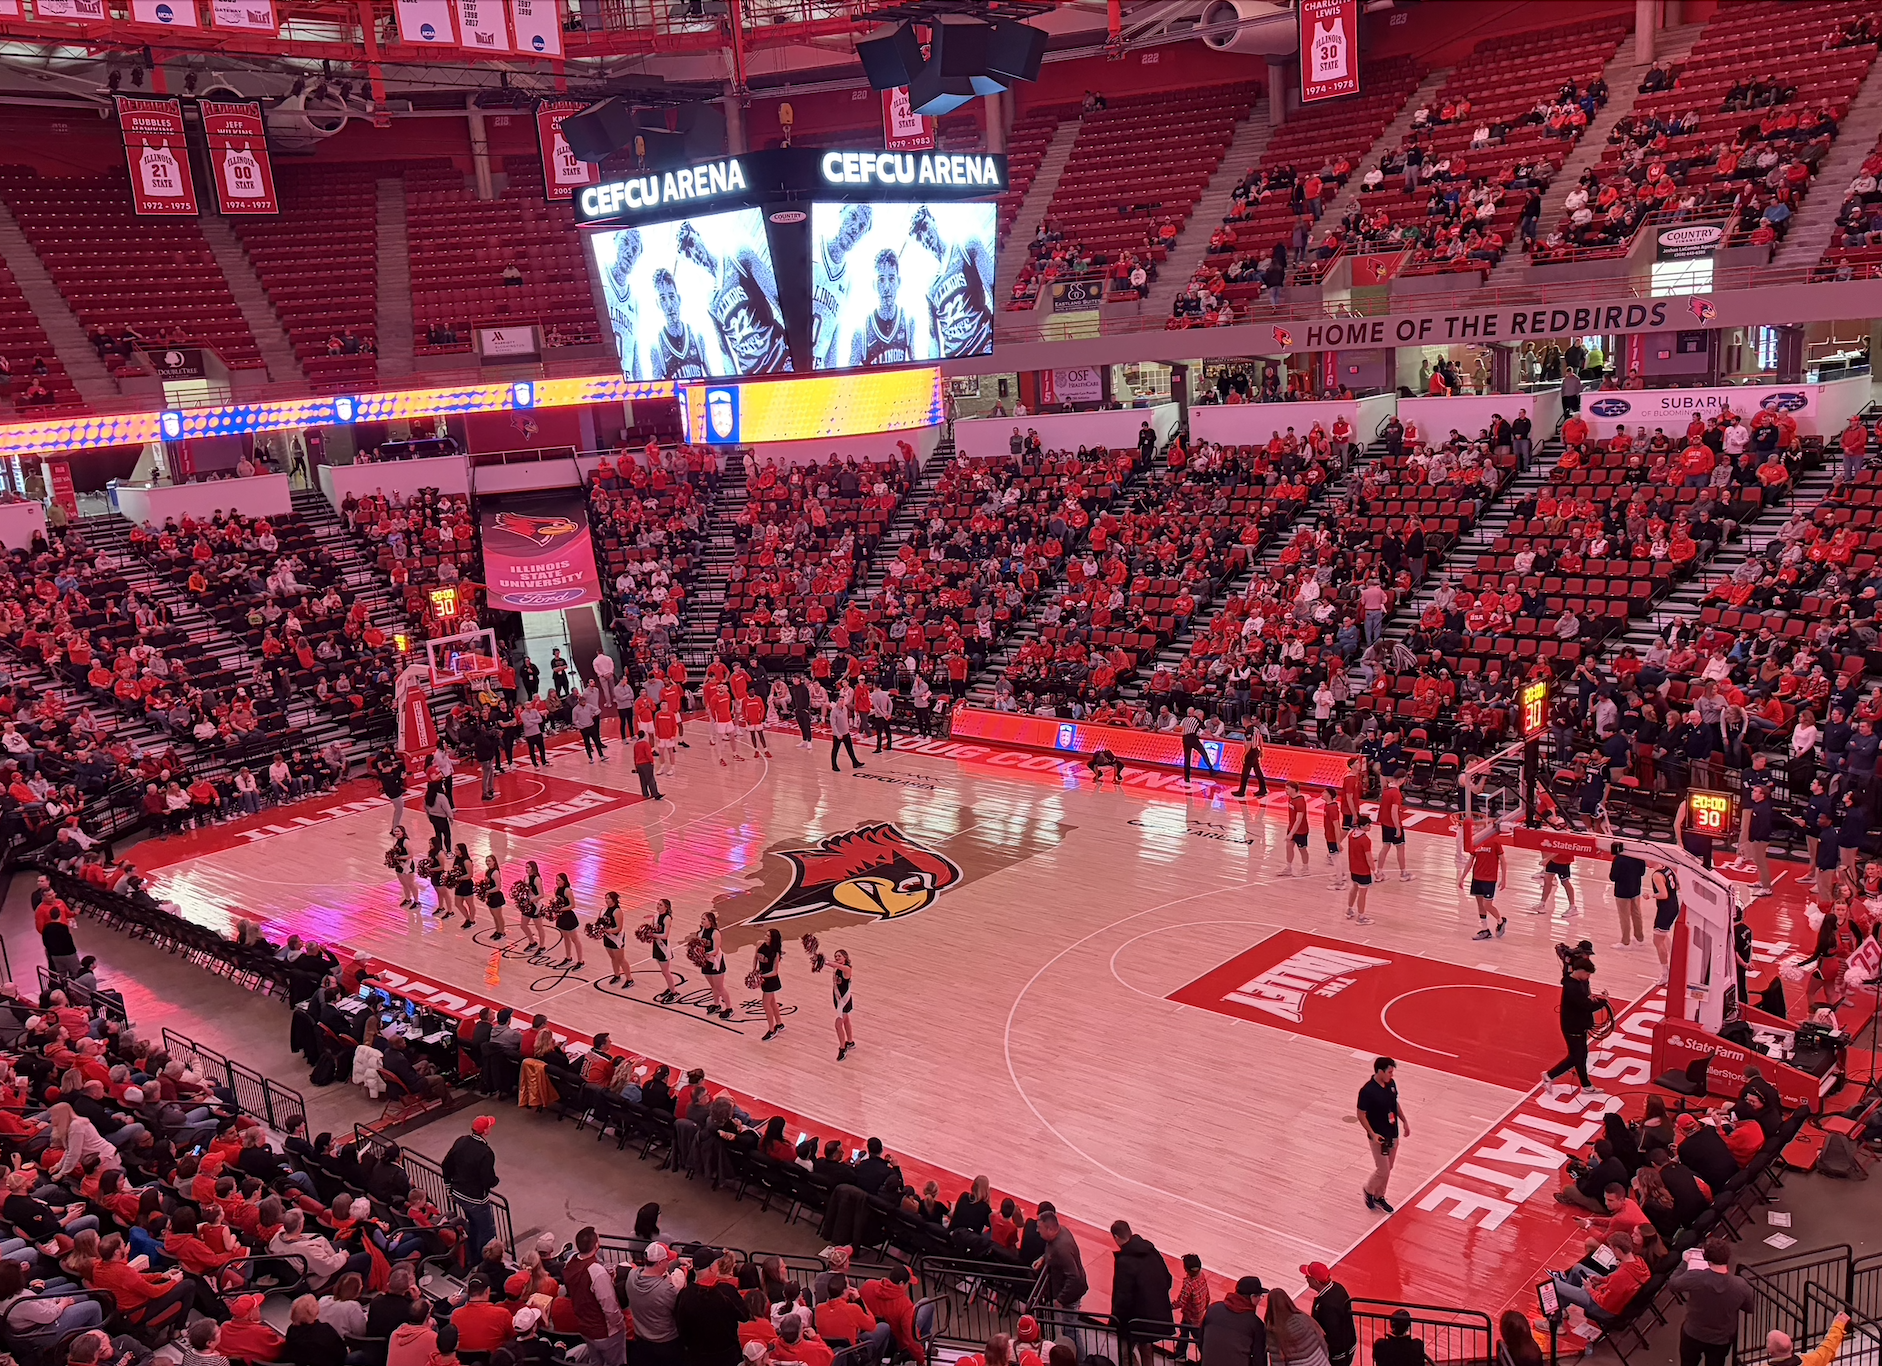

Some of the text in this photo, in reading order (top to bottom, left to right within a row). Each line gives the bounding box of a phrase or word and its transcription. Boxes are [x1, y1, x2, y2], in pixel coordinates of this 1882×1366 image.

[464, 3, 477, 11] 1997
[518, 8, 532, 16] 1998
[1315, 6, 1341, 19] LEWIS
[464, 11, 478, 19] 1998
[1389, 13, 1408, 26] 223
[465, 19, 479, 27] 2017
[1315, 34, 1342, 49] ILLINOIS
[1141, 52, 1160, 64] 222
[1320, 45, 1338, 60] 30
[1319, 60, 1339, 71] STATE
[1305, 85, 1326, 96] 1974
[1333, 79, 1354, 91] 1978
[851, 90, 868, 101] 220
[118, 97, 179, 115] REDBIRDS
[202, 100, 260, 116] REDBIRDS
[897, 106, 914, 119] 44
[132, 117, 172, 127] BUBBLES
[225, 121, 244, 129] JEFF
[898, 119, 916, 129] STATE
[888, 140, 906, 148] 1979
[912, 136, 931, 146] 1983
[144, 154, 174, 166] ILLINOIS
[227, 156, 255, 168] ILLINOIS
[563, 154, 578, 167] 10
[151, 164, 168, 178] 21
[234, 166, 252, 179] 00
[562, 167, 581, 176] STATE
[822, 151, 1000, 185] CEFCU ARENA
[152, 179, 173, 188] STATE
[235, 181, 255, 189] STATE
[580, 158, 747, 217] CEFCU ARENA
[142, 202, 164, 210] 1972
[170, 202, 192, 210] 1975
[226, 201, 246, 209] 1974
[252, 201, 272, 209] 1977
[1666, 229, 1715, 241] COUNTRY
[1306, 302, 1667, 347] HOME OF THE REDBIRDS
[1326, 351, 1334, 387] 116
[1068, 370, 1089, 382] OSF
[1043, 370, 1052, 402] 115
[1661, 396, 1729, 409] SUBARU
[1653, 408, 1711, 417] BLOOMINGON
[1714, 407, 1748, 415] NMAL
[510, 560, 571, 573] ILLINOIS
[500, 571, 584, 588] UNIVERSITY
[520, 569, 563, 581] STATE
[431, 588, 455, 601] 20:00
[519, 592, 570, 604] Ford
[436, 600, 455, 617] 30
[1524, 682, 1545, 705] 20:00
[1525, 700, 1542, 731] 30
[898, 780, 937, 791] AREN
[234, 773, 479, 842] ILLINS
[482, 789, 621, 828] VALLEY
[1692, 795, 1727, 812] 20:00
[1699, 810, 1721, 827] 30
[1219, 945, 1393, 1024] VALLEY
[1313, 976, 1358, 998] THE
[1783, 1095, 1799, 1103] Jeep
[1414, 1083, 1625, 1231] STATE
